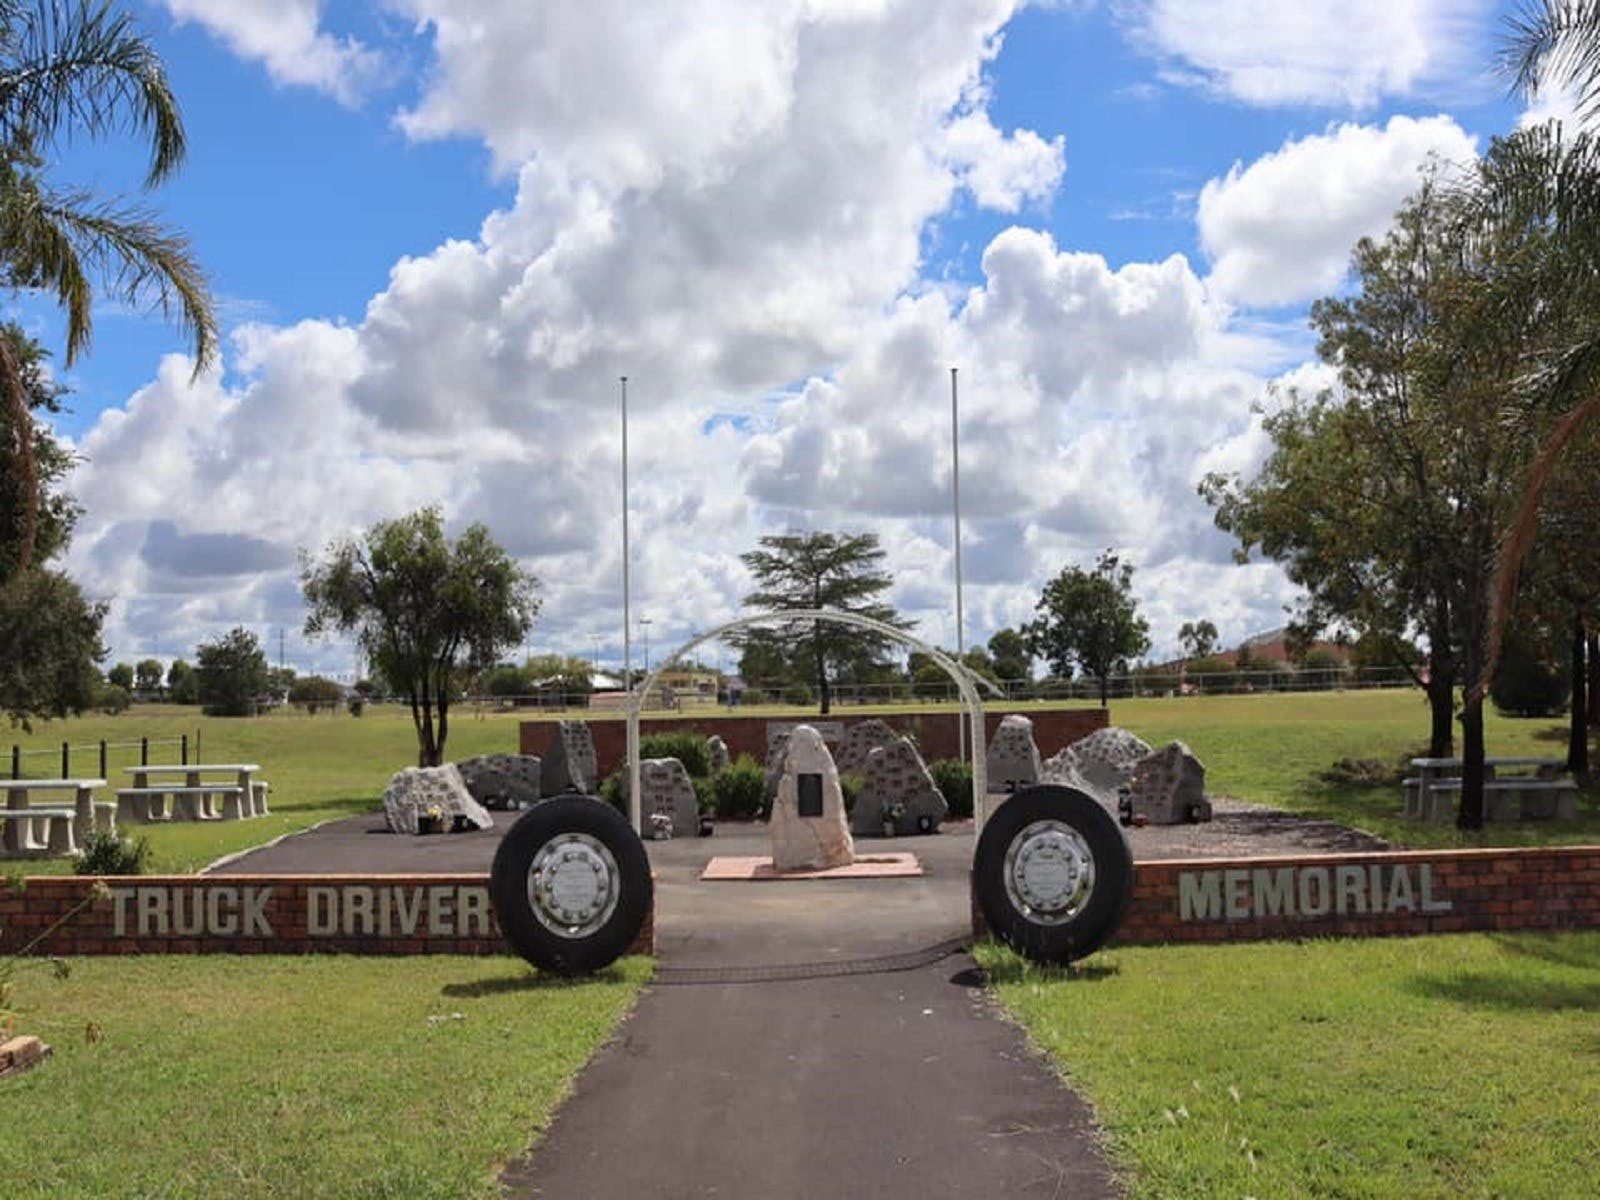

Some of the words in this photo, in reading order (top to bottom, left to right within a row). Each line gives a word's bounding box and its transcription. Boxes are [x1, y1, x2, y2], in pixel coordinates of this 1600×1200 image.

[113, 886, 273, 936] TRUCK
[307, 886, 502, 936] DRIVER
[1179, 864, 1452, 921] MEMORIAL
